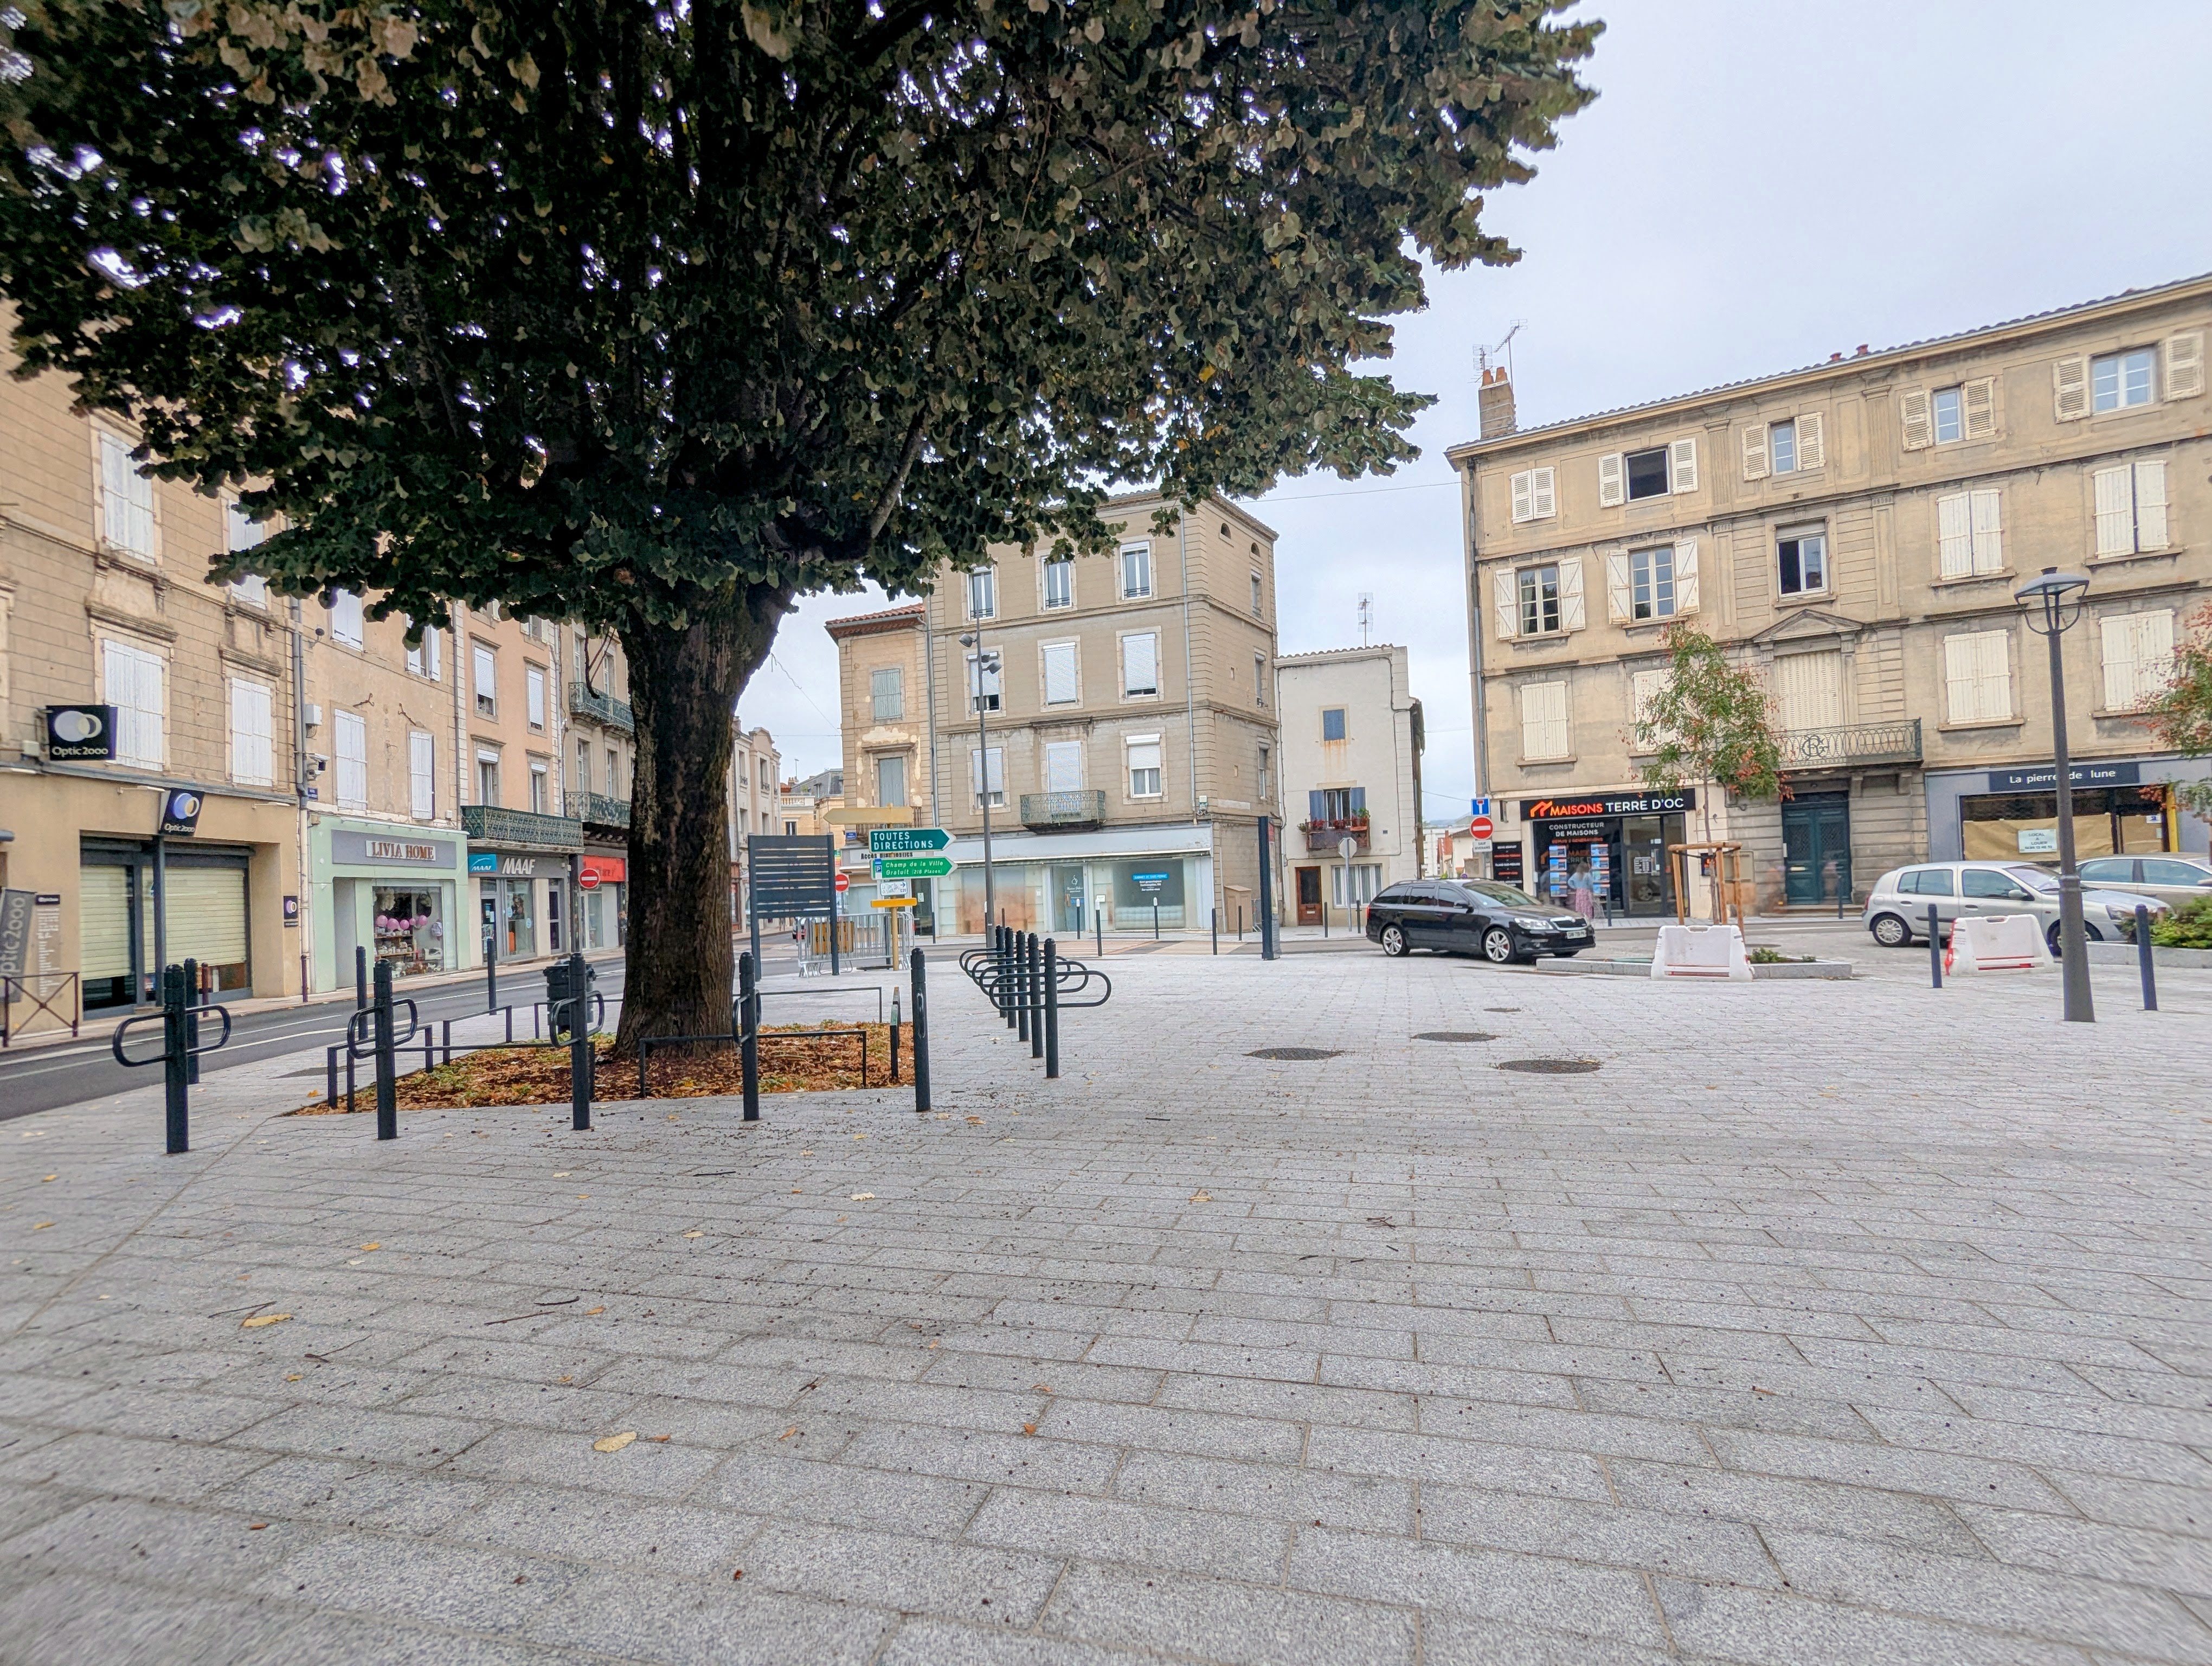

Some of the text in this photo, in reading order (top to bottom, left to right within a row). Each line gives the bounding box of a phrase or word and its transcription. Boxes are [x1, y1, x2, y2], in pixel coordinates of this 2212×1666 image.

[2027, 774, 2057, 784] pierre
[1549, 798, 1684, 816] MAISONS TERRE D'OC
[1549, 822, 1605, 830] CONSTRUCTEUR
[874, 832, 910, 841] TOUTES
[371, 842, 434, 859] LIVIA HOME
[874, 841, 933, 850] DIRECTIONS
[502, 857, 536, 875] MAAF
